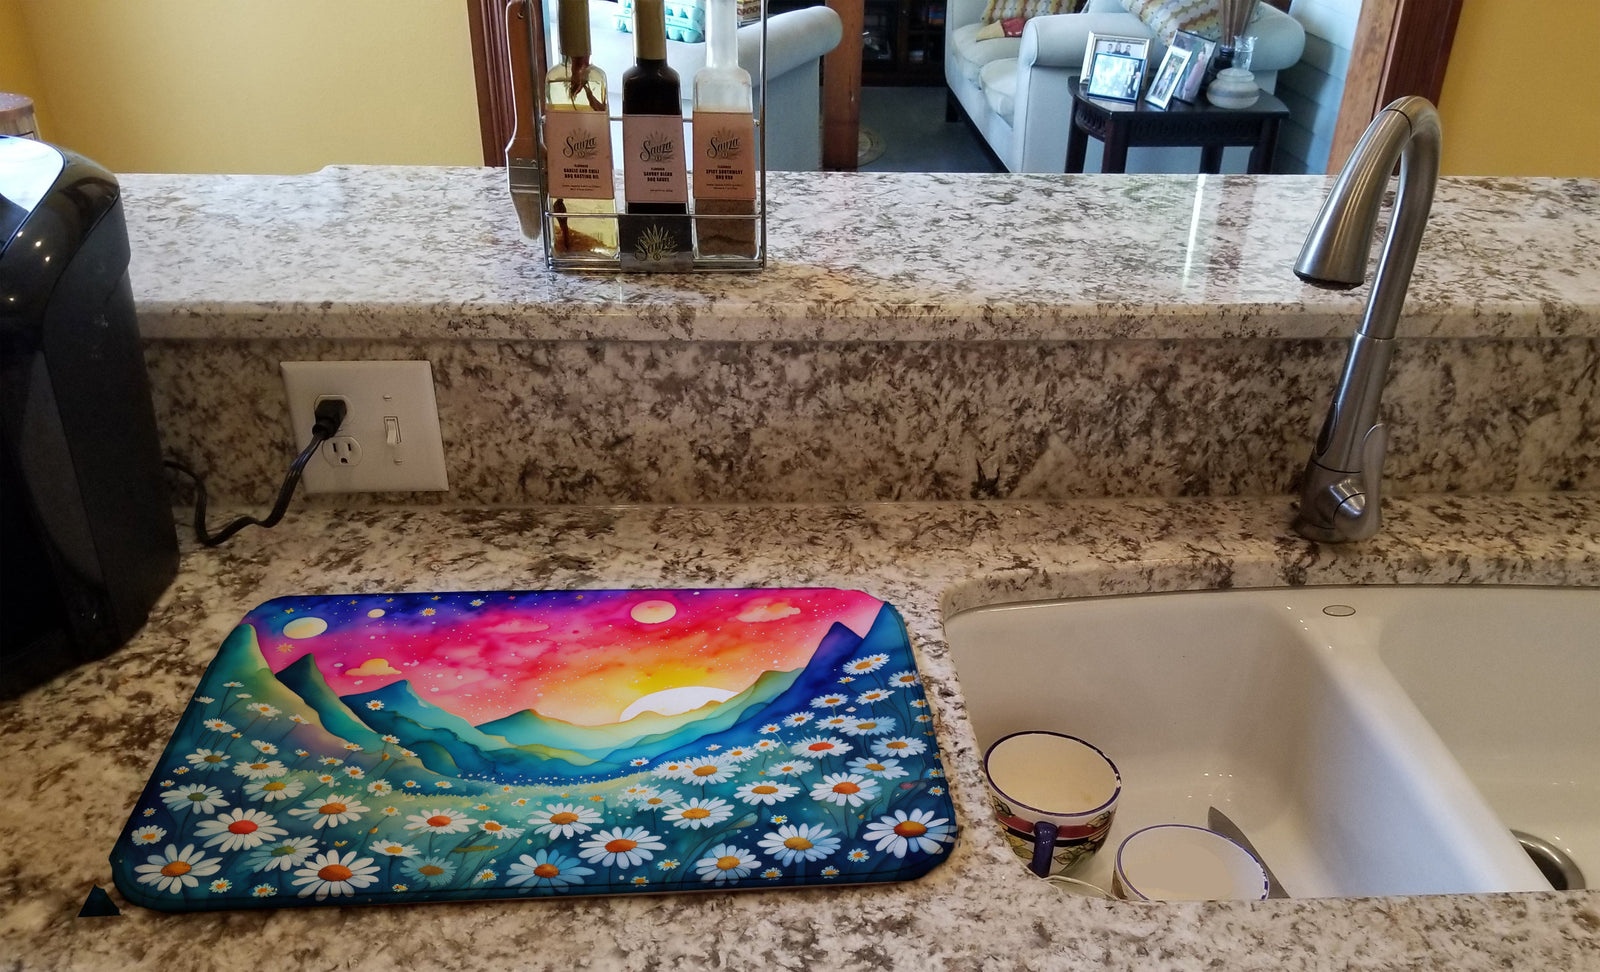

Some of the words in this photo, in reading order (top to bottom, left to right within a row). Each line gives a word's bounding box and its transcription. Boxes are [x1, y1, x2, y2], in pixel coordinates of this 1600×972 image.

[563, 136, 597, 158] Sauza
[640, 139, 673, 162] Sauza
[706, 137, 741, 159] Sauza
